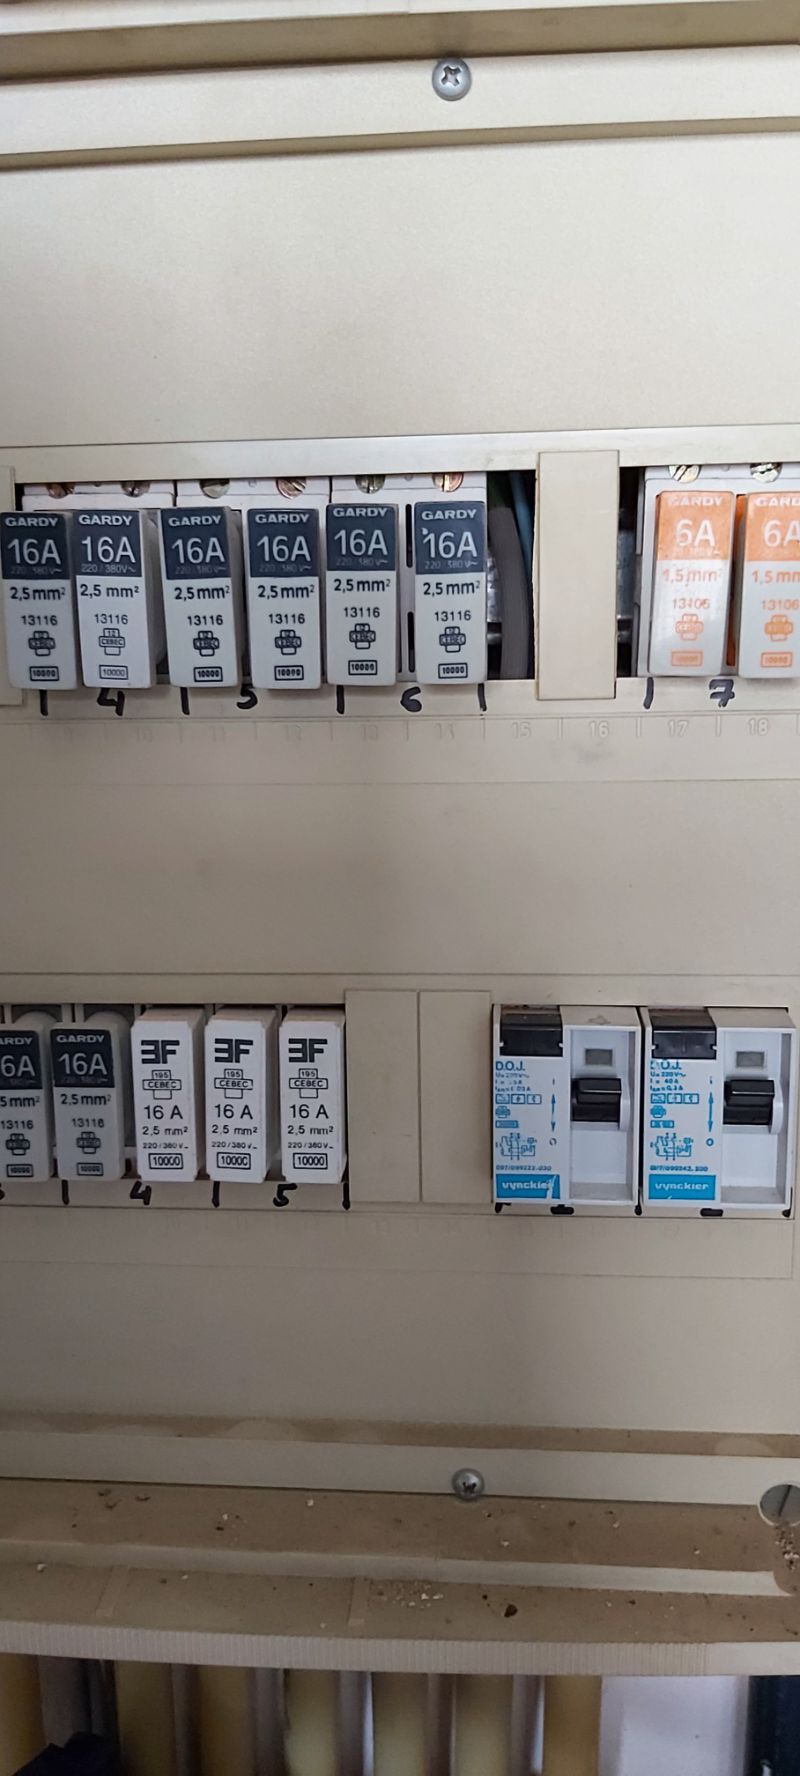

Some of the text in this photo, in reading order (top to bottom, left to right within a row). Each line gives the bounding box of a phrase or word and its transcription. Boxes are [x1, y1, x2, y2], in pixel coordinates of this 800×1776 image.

[333, 507, 388, 518] GARDY
[422, 509, 476, 520] GARDY
[5, 517, 58, 527] GARDY
[79, 515, 133, 526] GARDY
[168, 515, 221, 526] GARDY
[255, 514, 310, 524] GARDY
[675, 519, 716, 547] 6A
[257, 535, 311, 562] 16A
[334, 529, 388, 556] 16A
[423, 531, 477, 559] 16A
[7, 538, 61, 565] 16A
[81, 536, 136, 564] 16A
[171, 537, 225, 564] 16A
[80, 584, 101, 598] 2,5
[334, 578, 354, 593] 2,5
[423, 582, 443, 597] 2,5
[10, 586, 30, 601] 2,5
[174, 587, 195, 601] 2,5
[258, 585, 278, 599] 2,5
[344, 606, 380, 618] 13116
[434, 610, 471, 621] 13116
[21, 615, 58, 626] 13116
[94, 614, 128, 625] 13116
[187, 615, 223, 626] 13116
[269, 613, 305, 624] 13116
[400, 686, 422, 712] 6
[709, 679, 735, 708] 7
[97, 688, 125, 716] 4
[590, 720, 608, 738] 16
[667, 719, 688, 737] 17
[748, 718, 769, 736] 18
[56, 1035, 105, 1043] GARDY
[58, 1053, 107, 1076] 16A
[226, 1070, 241, 1078] 195
[147, 1081, 177, 1089] CEBEC
[219, 1080, 249, 1088] CEBEC
[61, 1094, 79, 1106] 2,5
[144, 1105, 183, 1120] 16 A
[214, 1104, 253, 1120] 16 A
[289, 1104, 329, 1119] 16 A
[1, 1120, 34, 1130] 13116
[72, 1118, 105, 1128] 13116
[142, 1126, 160, 1136] 2,5
[211, 1124, 229, 1135] 2,5
[287, 1125, 305, 1135] 2,5
[297, 1156, 325, 1166] 10000
[655, 1182, 709, 1191] vynckier
[130, 1181, 152, 1205] 4
[273, 1183, 297, 1207] 5
